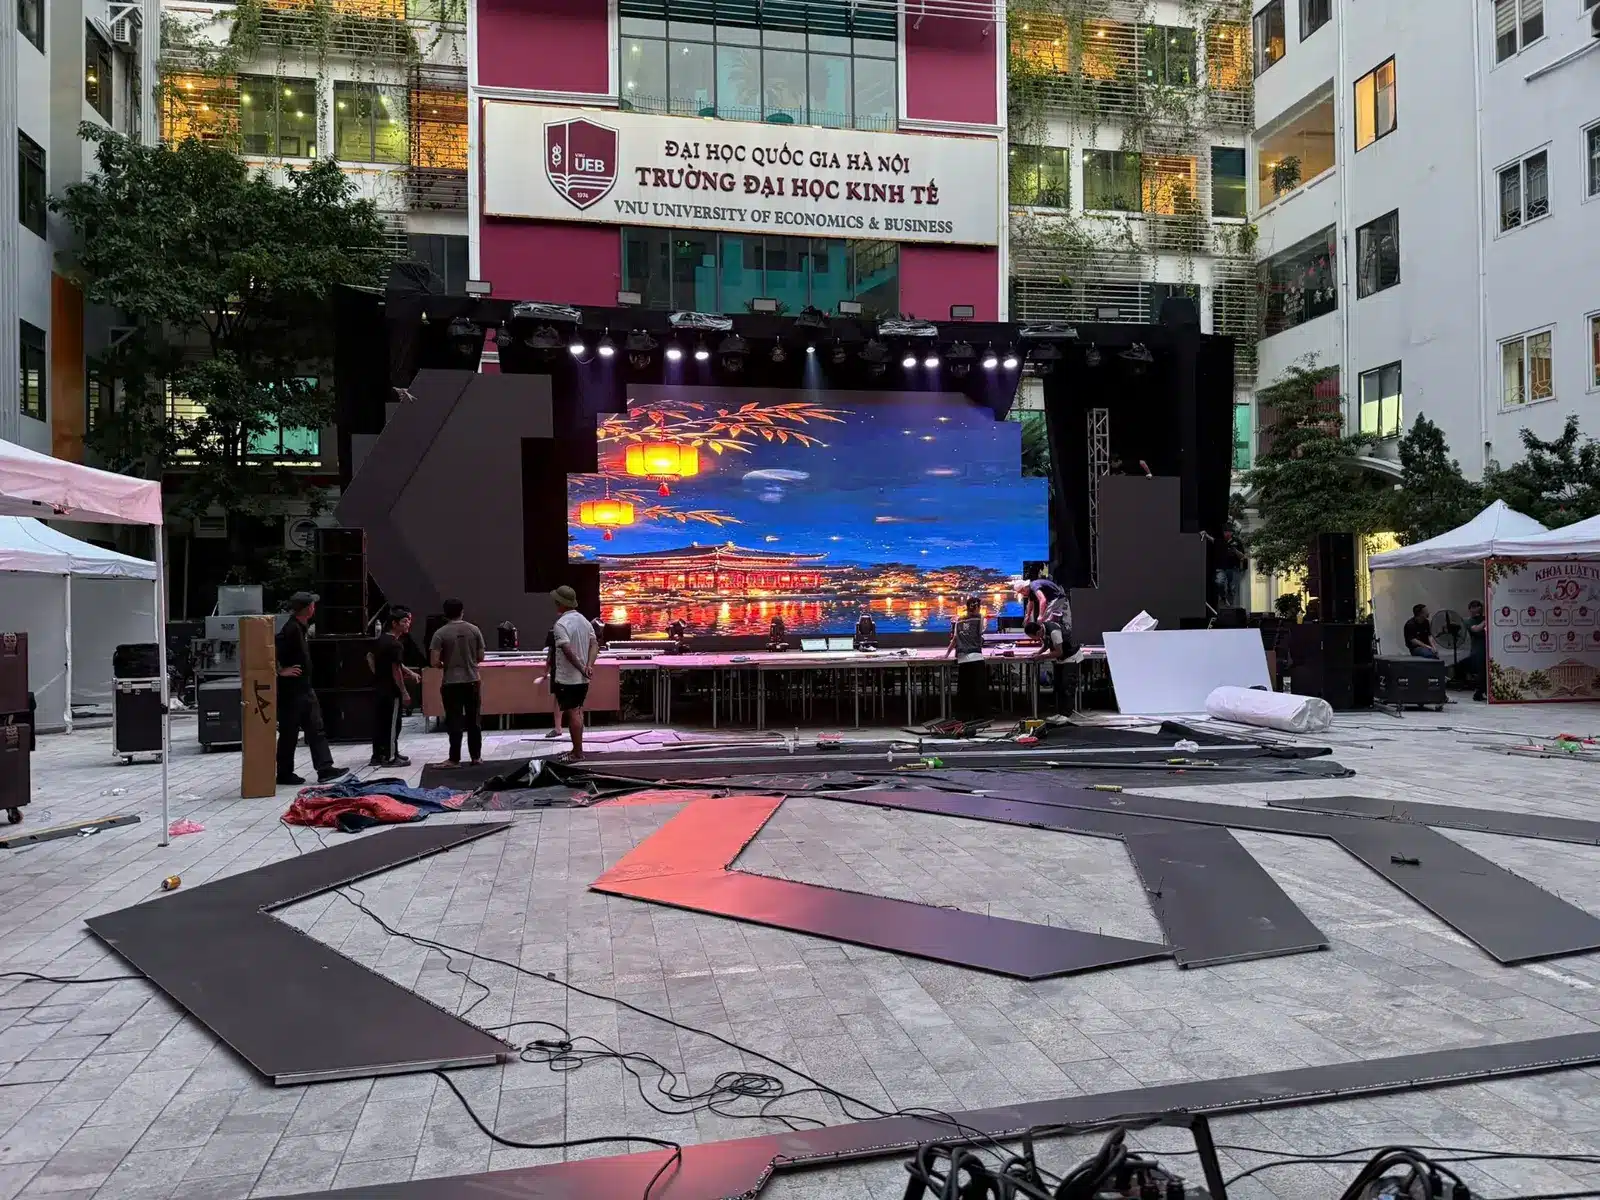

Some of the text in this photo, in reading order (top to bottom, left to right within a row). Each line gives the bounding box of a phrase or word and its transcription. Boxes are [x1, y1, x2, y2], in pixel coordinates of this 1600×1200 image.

[575, 158, 605, 172] UEB
[665, 140, 910, 175] ĐẠI HỌC QUỐC GIA HÀ NỘI
[635, 163, 939, 205] TRƯỜNG ĐẠI HỌC KINH TẾ
[614, 199, 953, 233] VNU UNIVERSITY OF ECONOMICS & BUSINESS
[1535, 565, 1562, 582] KHOA
[1556, 580, 1580, 600] 50
